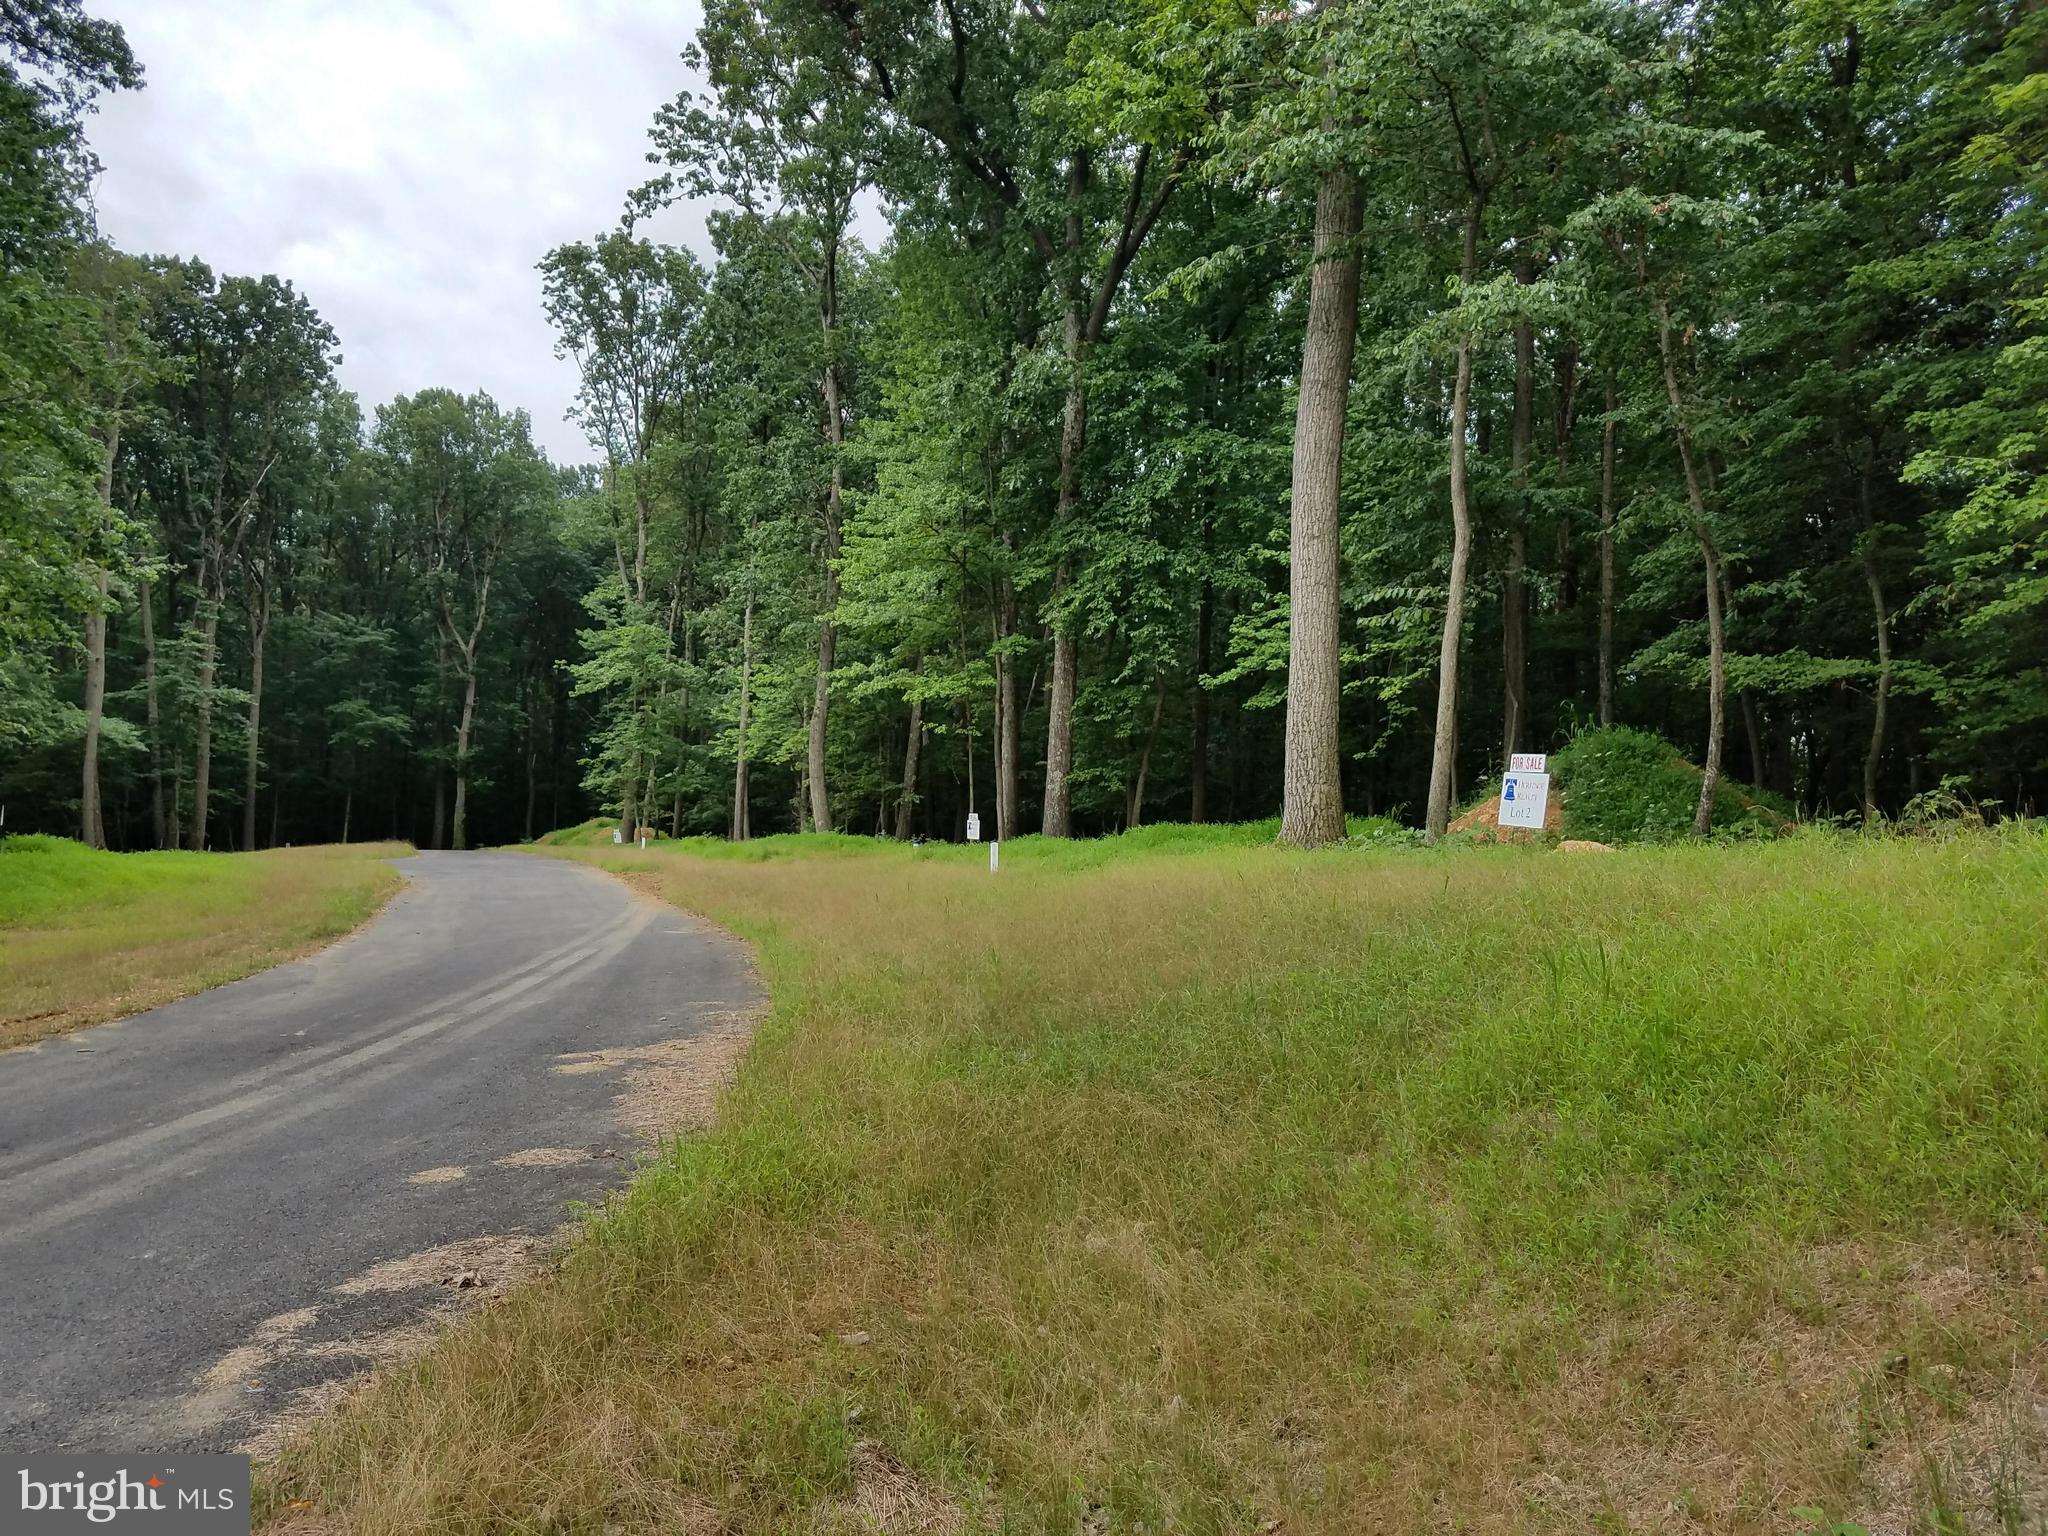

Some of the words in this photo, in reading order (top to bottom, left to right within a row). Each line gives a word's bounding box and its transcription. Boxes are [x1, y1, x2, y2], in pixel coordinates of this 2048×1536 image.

[1512, 757, 1523, 769] FOR
[1526, 757, 1543, 769] SALE
[1510, 807, 1523, 818] Lot
[1526, 807, 1532, 818] 2
